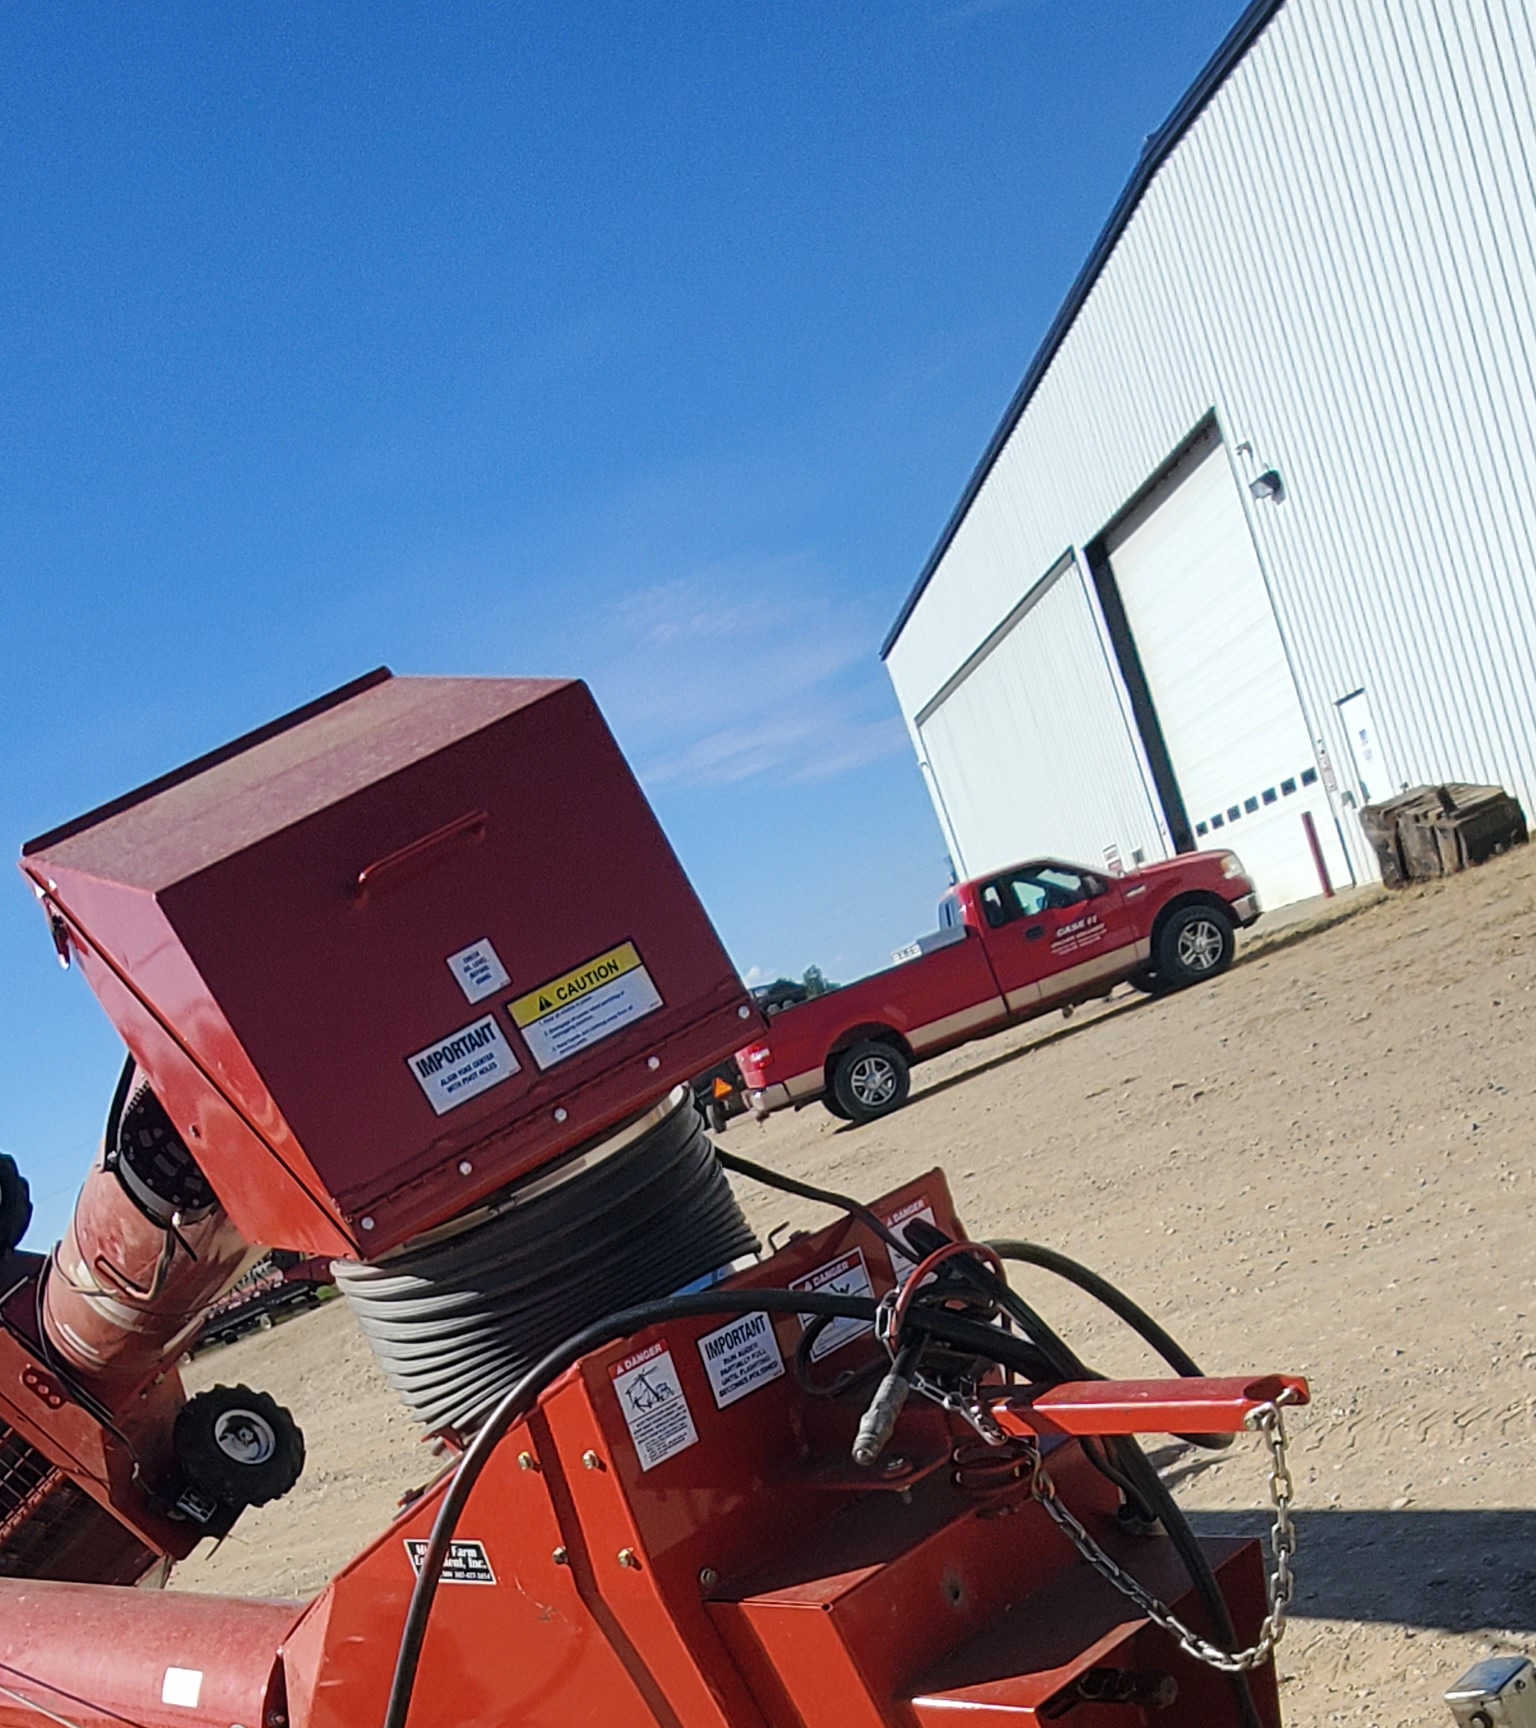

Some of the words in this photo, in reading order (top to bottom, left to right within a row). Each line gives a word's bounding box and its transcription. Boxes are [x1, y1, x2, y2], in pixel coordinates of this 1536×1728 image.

[1056, 919, 1085, 937] CASE
[556, 959, 619, 1000] CAUTION
[415, 1021, 496, 1078] IMPORTANT
[472, 1052, 495, 1069] CENTER
[478, 1061, 498, 1076] HOLES
[892, 1199, 925, 1223] DANGER
[813, 1261, 849, 1287] DANGER
[704, 1314, 766, 1361] IMPORTANT
[624, 1343, 662, 1370] DANGER
[720, 1356, 751, 1377] PARTIALLY
[751, 1348, 767, 1360] FULL
[723, 1353, 737, 1365] RUN
[738, 1342, 759, 1358] AUGER
[719, 1377, 749, 1397] BECOMES
[451, 1545, 478, 1557] Farm
[468, 1557, 487, 1569] Inc.
